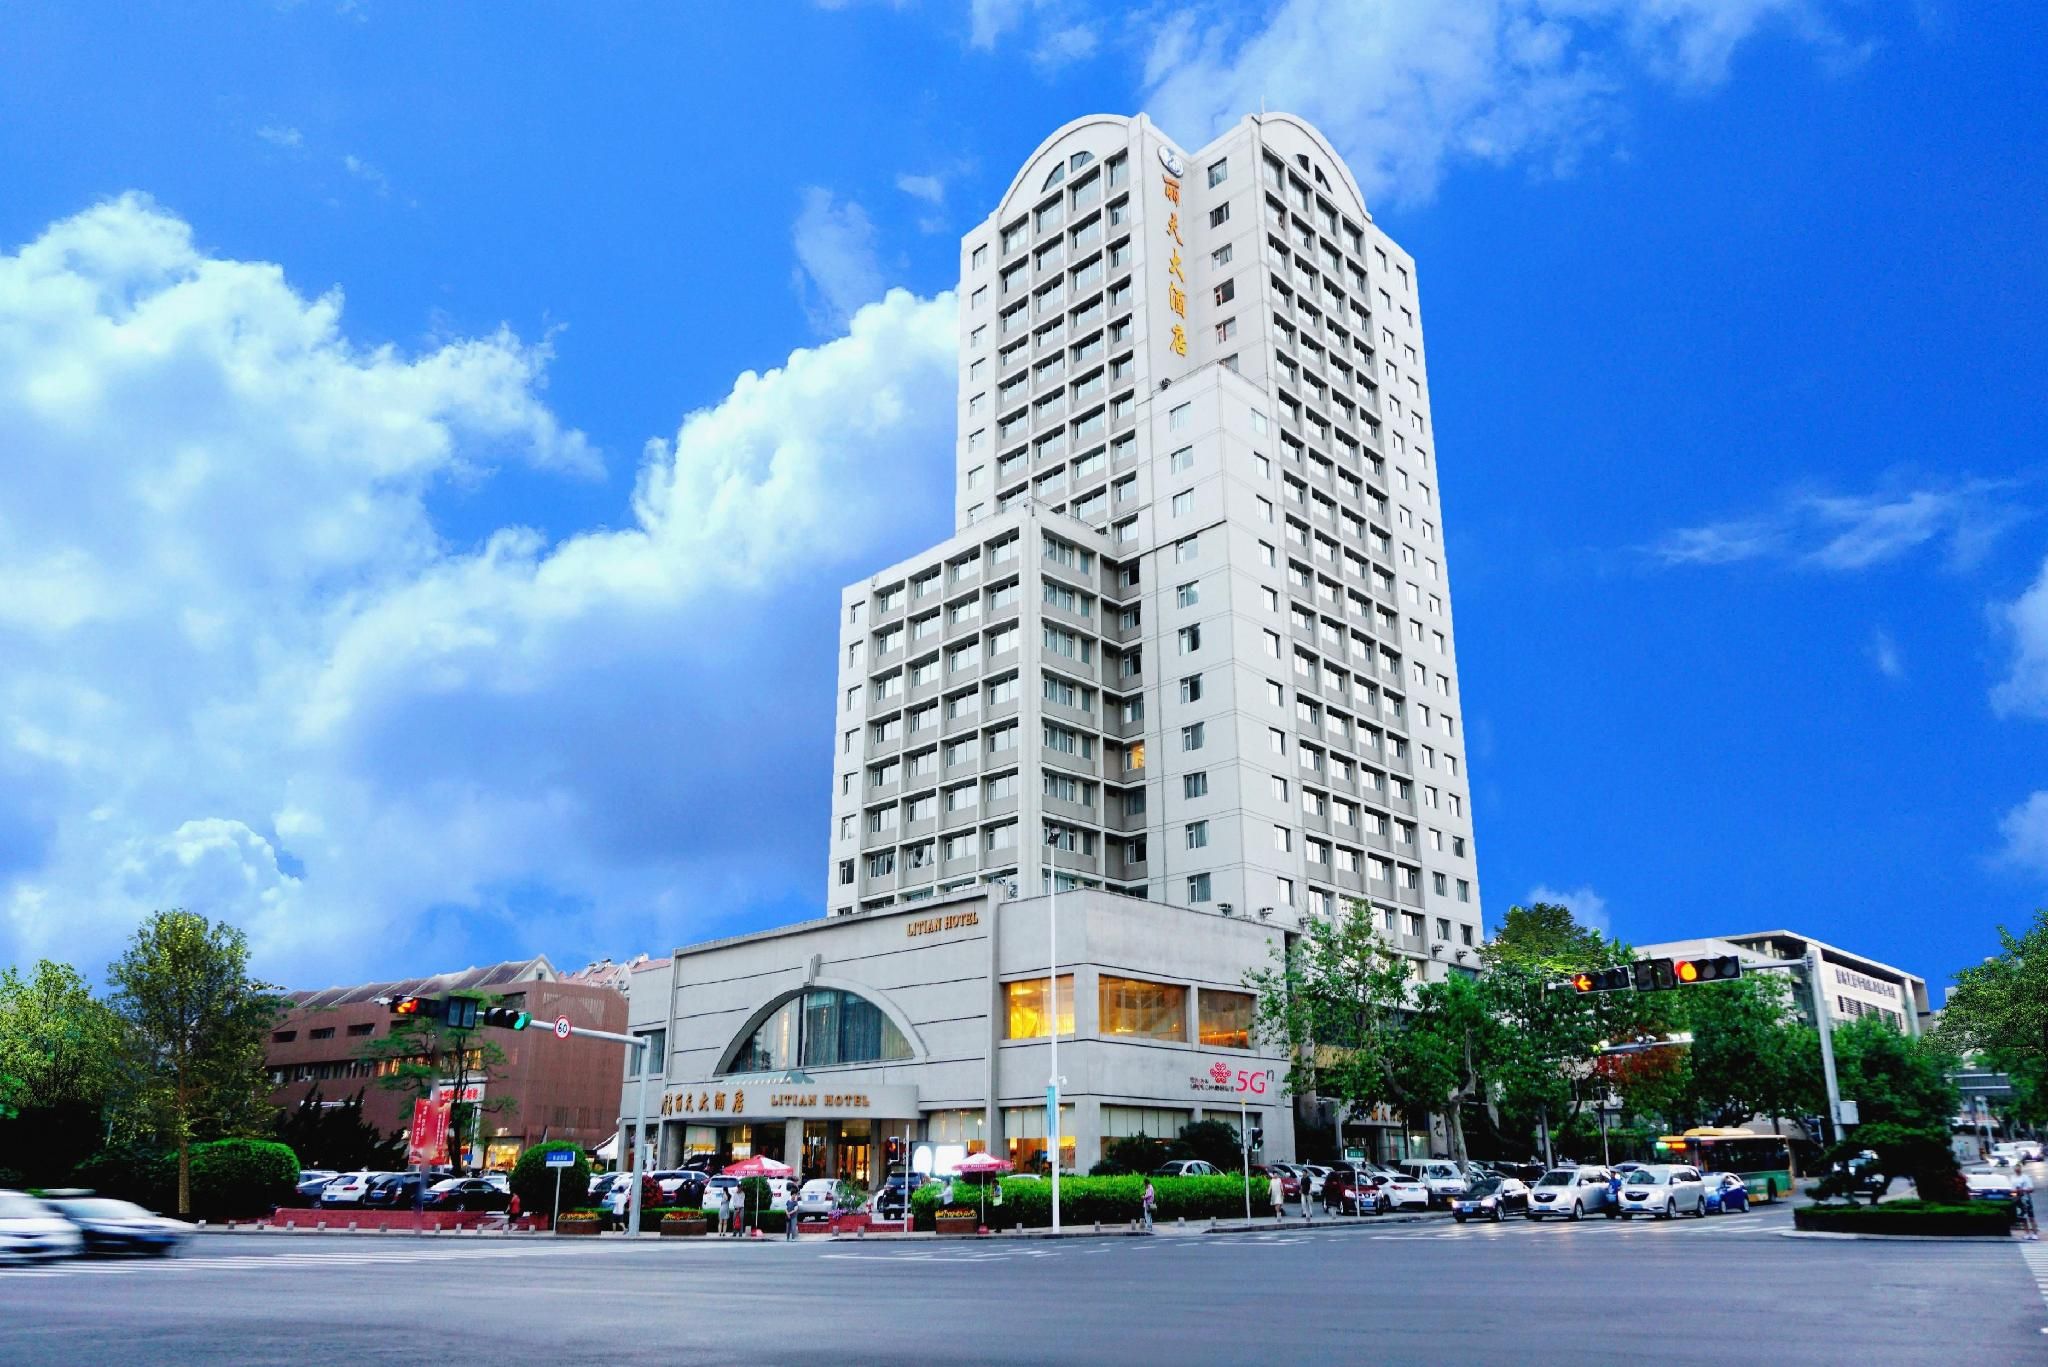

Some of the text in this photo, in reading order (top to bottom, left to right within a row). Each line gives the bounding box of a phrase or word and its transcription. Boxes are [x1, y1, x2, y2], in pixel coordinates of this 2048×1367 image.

[907, 912, 979, 936] LITIAN HOTEL
[558, 1022, 567, 1033] 60
[771, 1094, 870, 1107] LITIAN HOTEL
